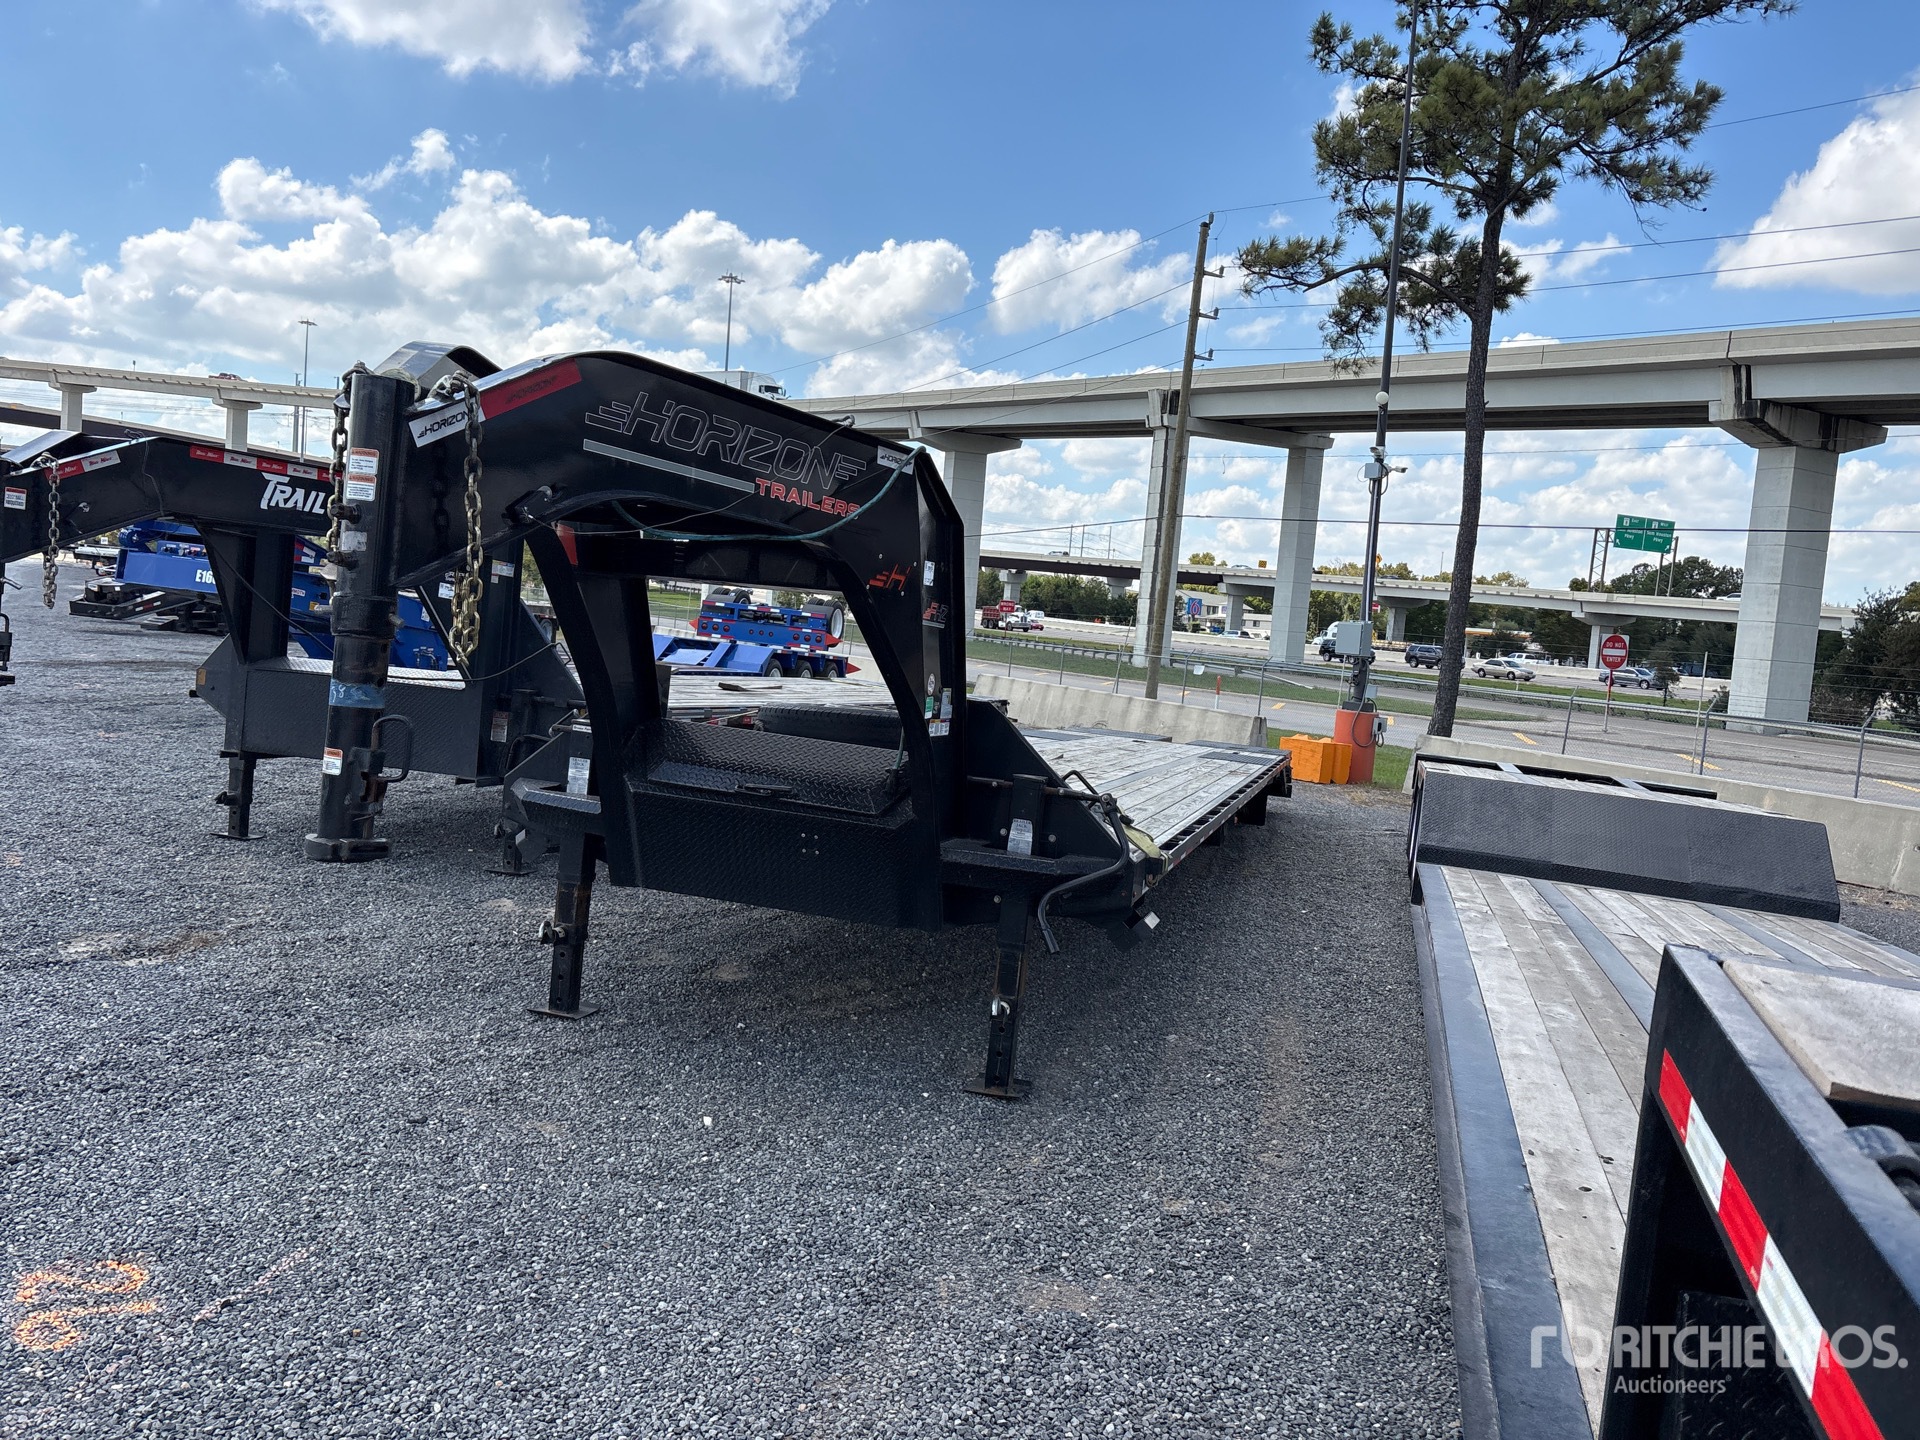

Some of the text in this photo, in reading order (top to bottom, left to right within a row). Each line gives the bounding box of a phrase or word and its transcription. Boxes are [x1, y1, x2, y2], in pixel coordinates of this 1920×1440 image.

[623, 391, 842, 490] HORIZON
[755, 477, 861, 520] TRAILERS
[1190, 599, 1200, 615] 6
